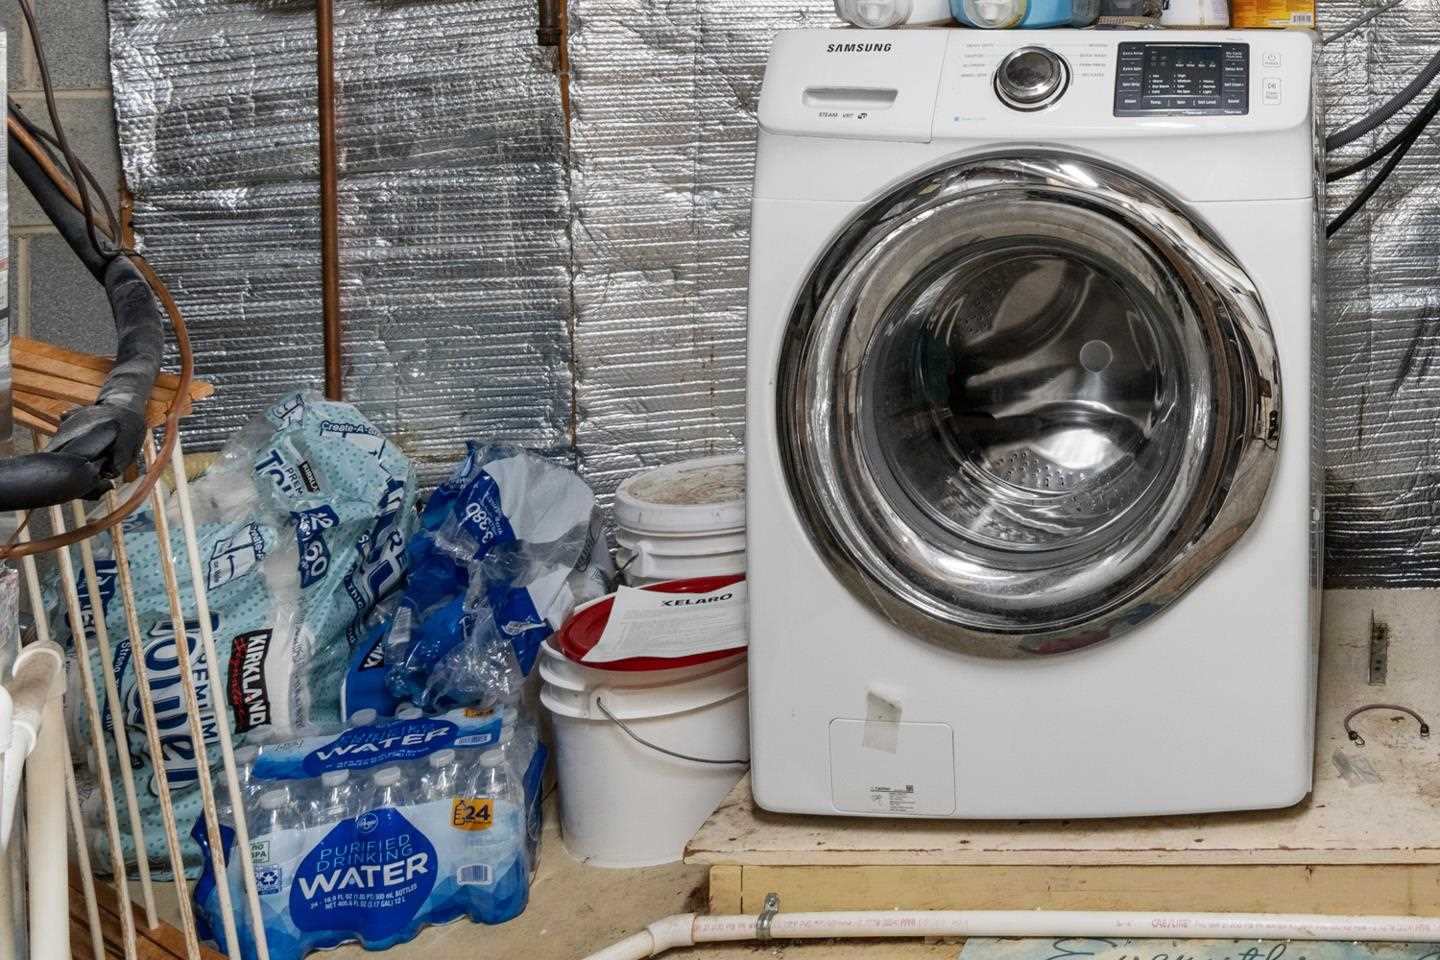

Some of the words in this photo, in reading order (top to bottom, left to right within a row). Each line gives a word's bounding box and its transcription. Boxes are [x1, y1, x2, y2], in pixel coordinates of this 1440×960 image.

[826, 42, 892, 53] SAMSUNG
[242, 633, 268, 727] KIRKLAND
[315, 726, 451, 761] WATER
[464, 804, 491, 821] 24
[315, 844, 413, 873] DRINKING
[319, 833, 411, 861] PURIFIED
[298, 851, 430, 901] WATER
